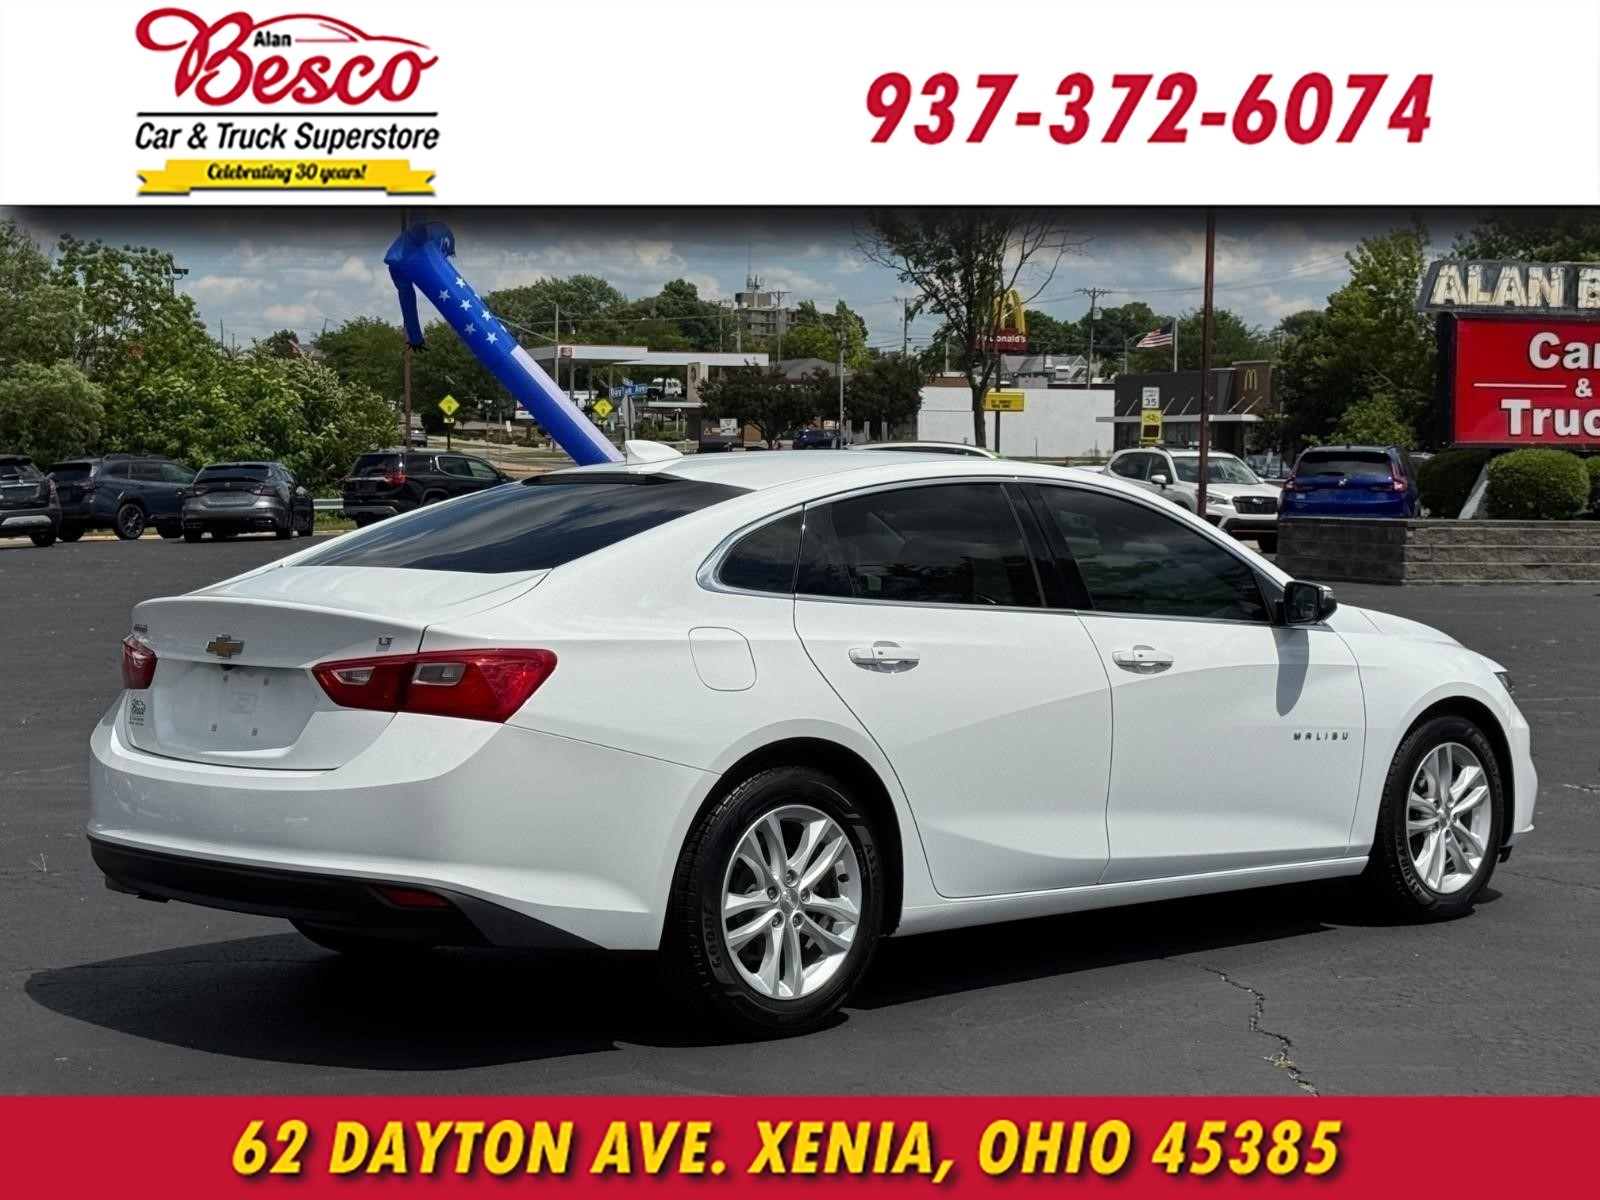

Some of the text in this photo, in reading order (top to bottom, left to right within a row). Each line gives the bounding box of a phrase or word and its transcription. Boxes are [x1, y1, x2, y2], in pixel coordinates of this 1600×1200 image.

[1429, 264, 1565, 307] ALAN
[1574, 377, 1593, 398] &
[1144, 398, 1157, 407] 35
[378, 636, 393, 647] LT
[1293, 731, 1349, 741] MALIBU
